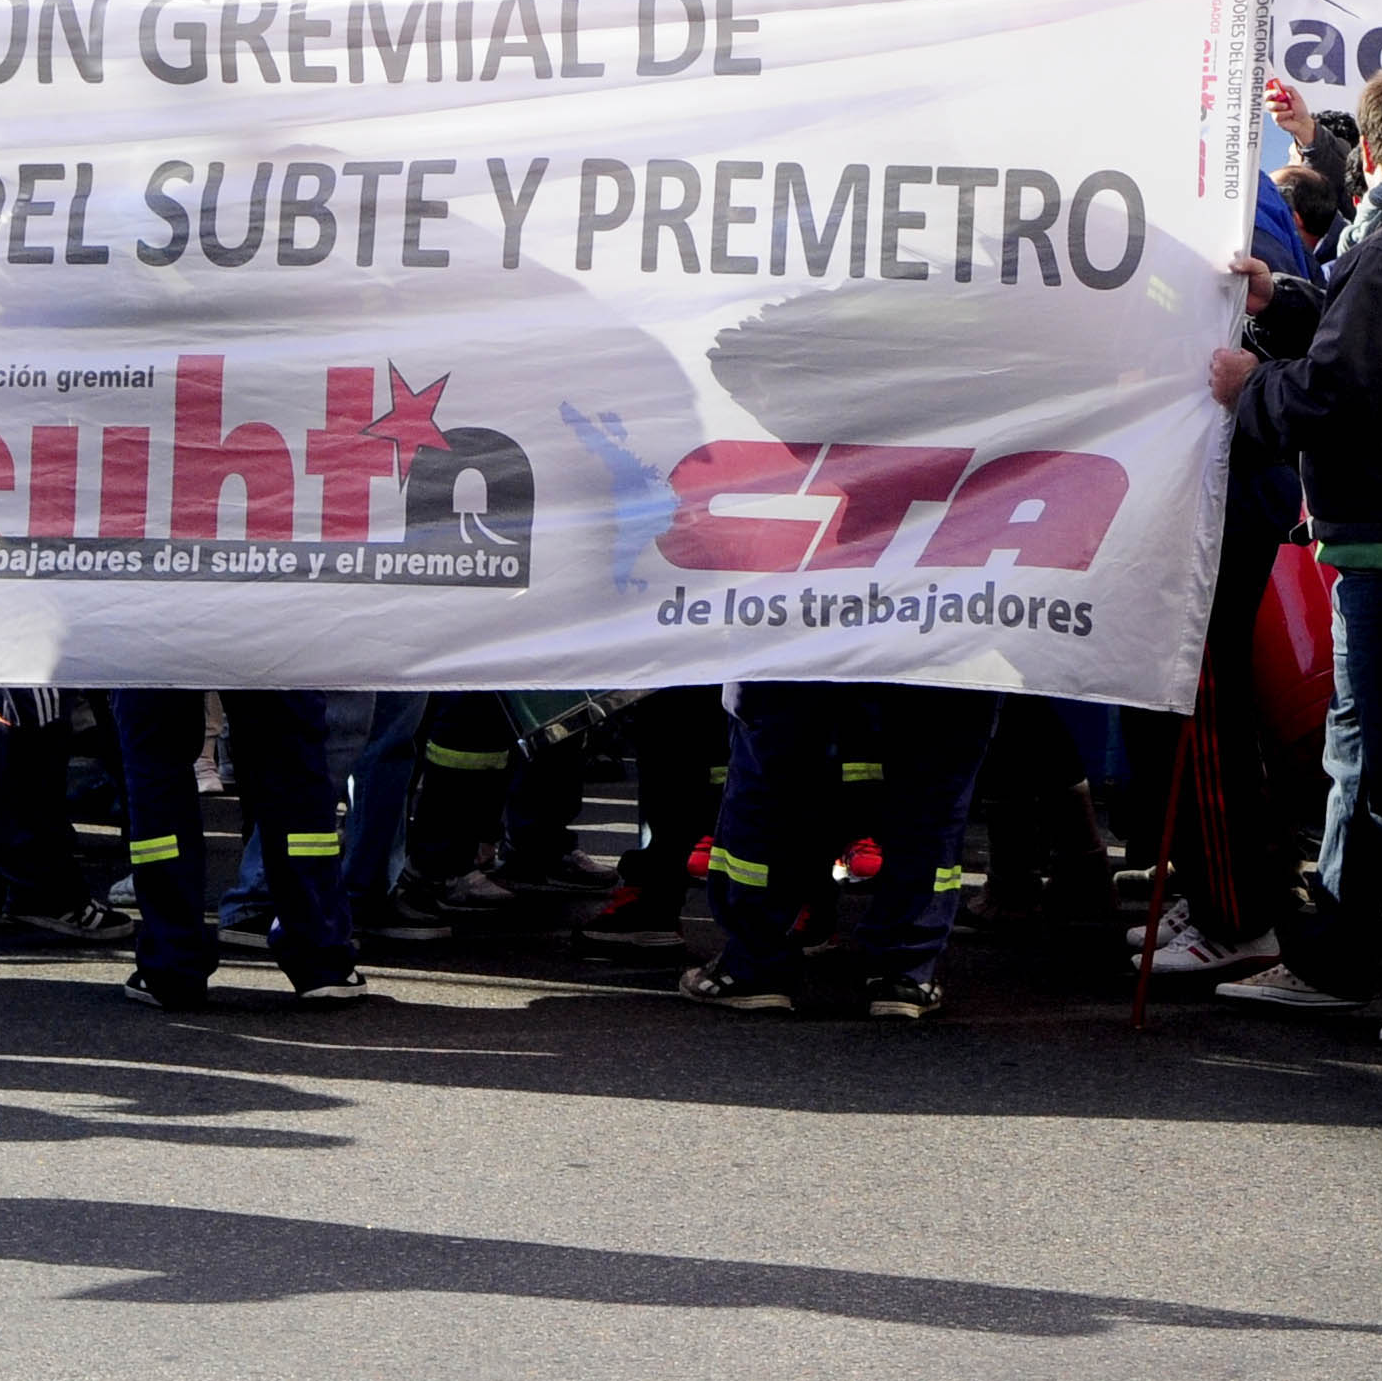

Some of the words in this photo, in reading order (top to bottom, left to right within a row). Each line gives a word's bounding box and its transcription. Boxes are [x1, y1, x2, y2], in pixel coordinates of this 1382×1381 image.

[1229, 41, 1245, 66] DEL
[1226, 67, 1243, 111] SUBTE
[1249, 65, 1266, 128] GREMIAL
[1226, 113, 1241, 122] Y
[1223, 126, 1241, 200] PREMETRO
[137, 159, 456, 269] SUBTE
[486, 157, 550, 270] Y
[574, 157, 1146, 291] PREMETRO
[56, 364, 156, 393] gremial
[654, 439, 1130, 573] CTA
[152, 543, 201, 573] del
[210, 545, 299, 574] subte
[308, 552, 327, 580] y
[335, 546, 366, 575] el
[374, 549, 521, 581] premetro
[656, 585, 713, 627] de
[722, 587, 788, 628] los
[799, 580, 1094, 637] trabajadores
